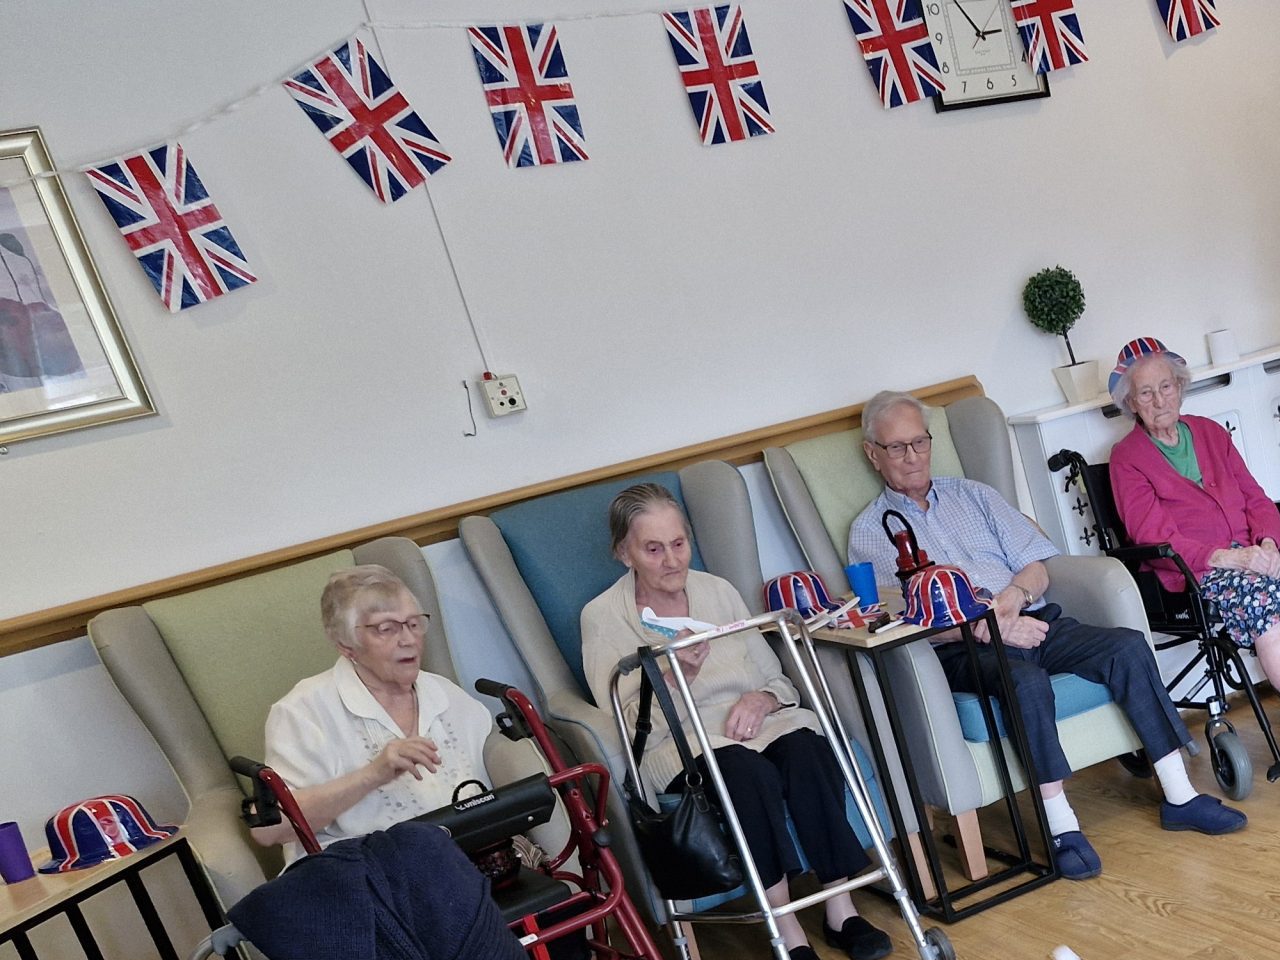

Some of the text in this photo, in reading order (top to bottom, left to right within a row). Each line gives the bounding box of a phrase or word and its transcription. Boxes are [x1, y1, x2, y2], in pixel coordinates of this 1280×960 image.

[926, 2, 940, 16] 10
[935, 32, 943, 45] 9
[942, 61, 950, 74] 8
[961, 80, 967, 93] 7
[986, 77, 994, 90] 6
[1011, 74, 1017, 87] 5
[464, 793, 495, 808] uniscan
